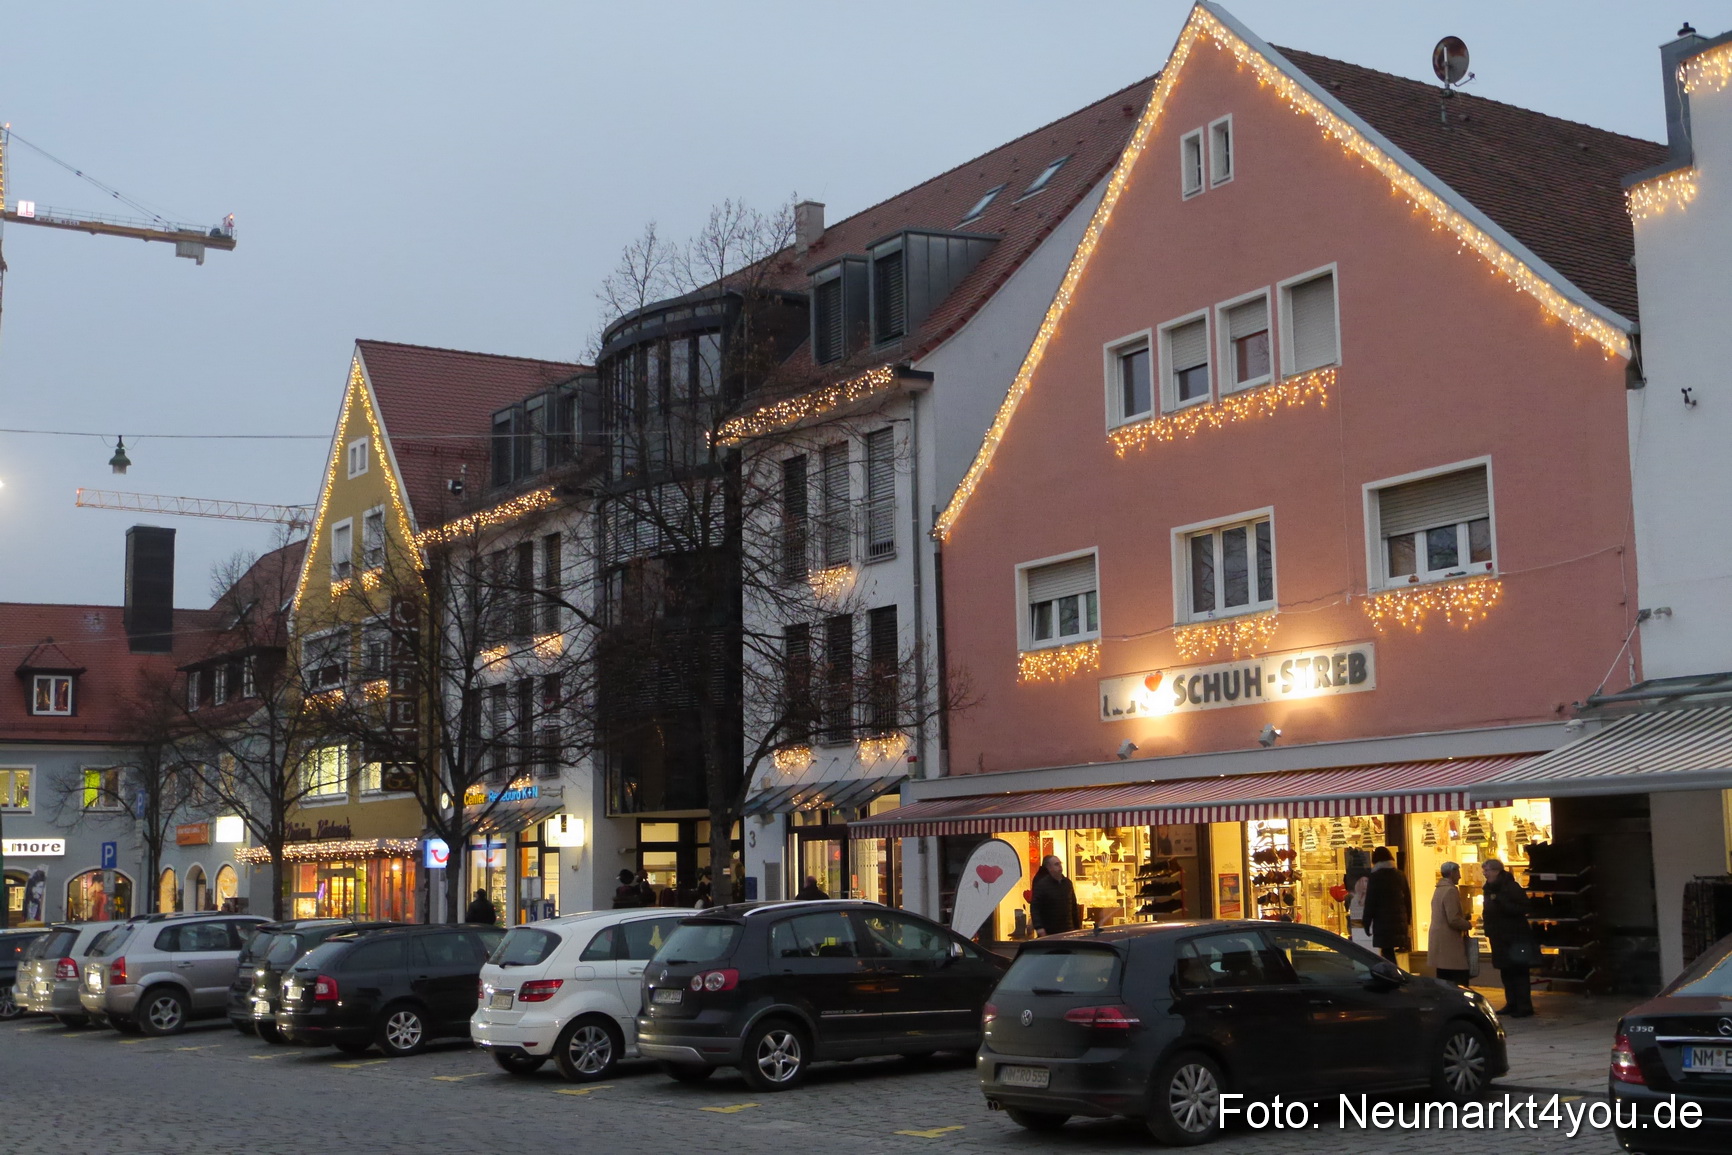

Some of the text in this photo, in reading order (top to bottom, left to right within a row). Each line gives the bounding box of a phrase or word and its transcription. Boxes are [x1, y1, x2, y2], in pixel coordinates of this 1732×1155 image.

[464, 792, 486, 805] Center
[522, 785, 539, 799] K+N
[12, 843, 61, 852] more
[749, 830, 757, 848] 3
[104, 845, 114, 866] P
[1693, 1049, 1714, 1066] NM
